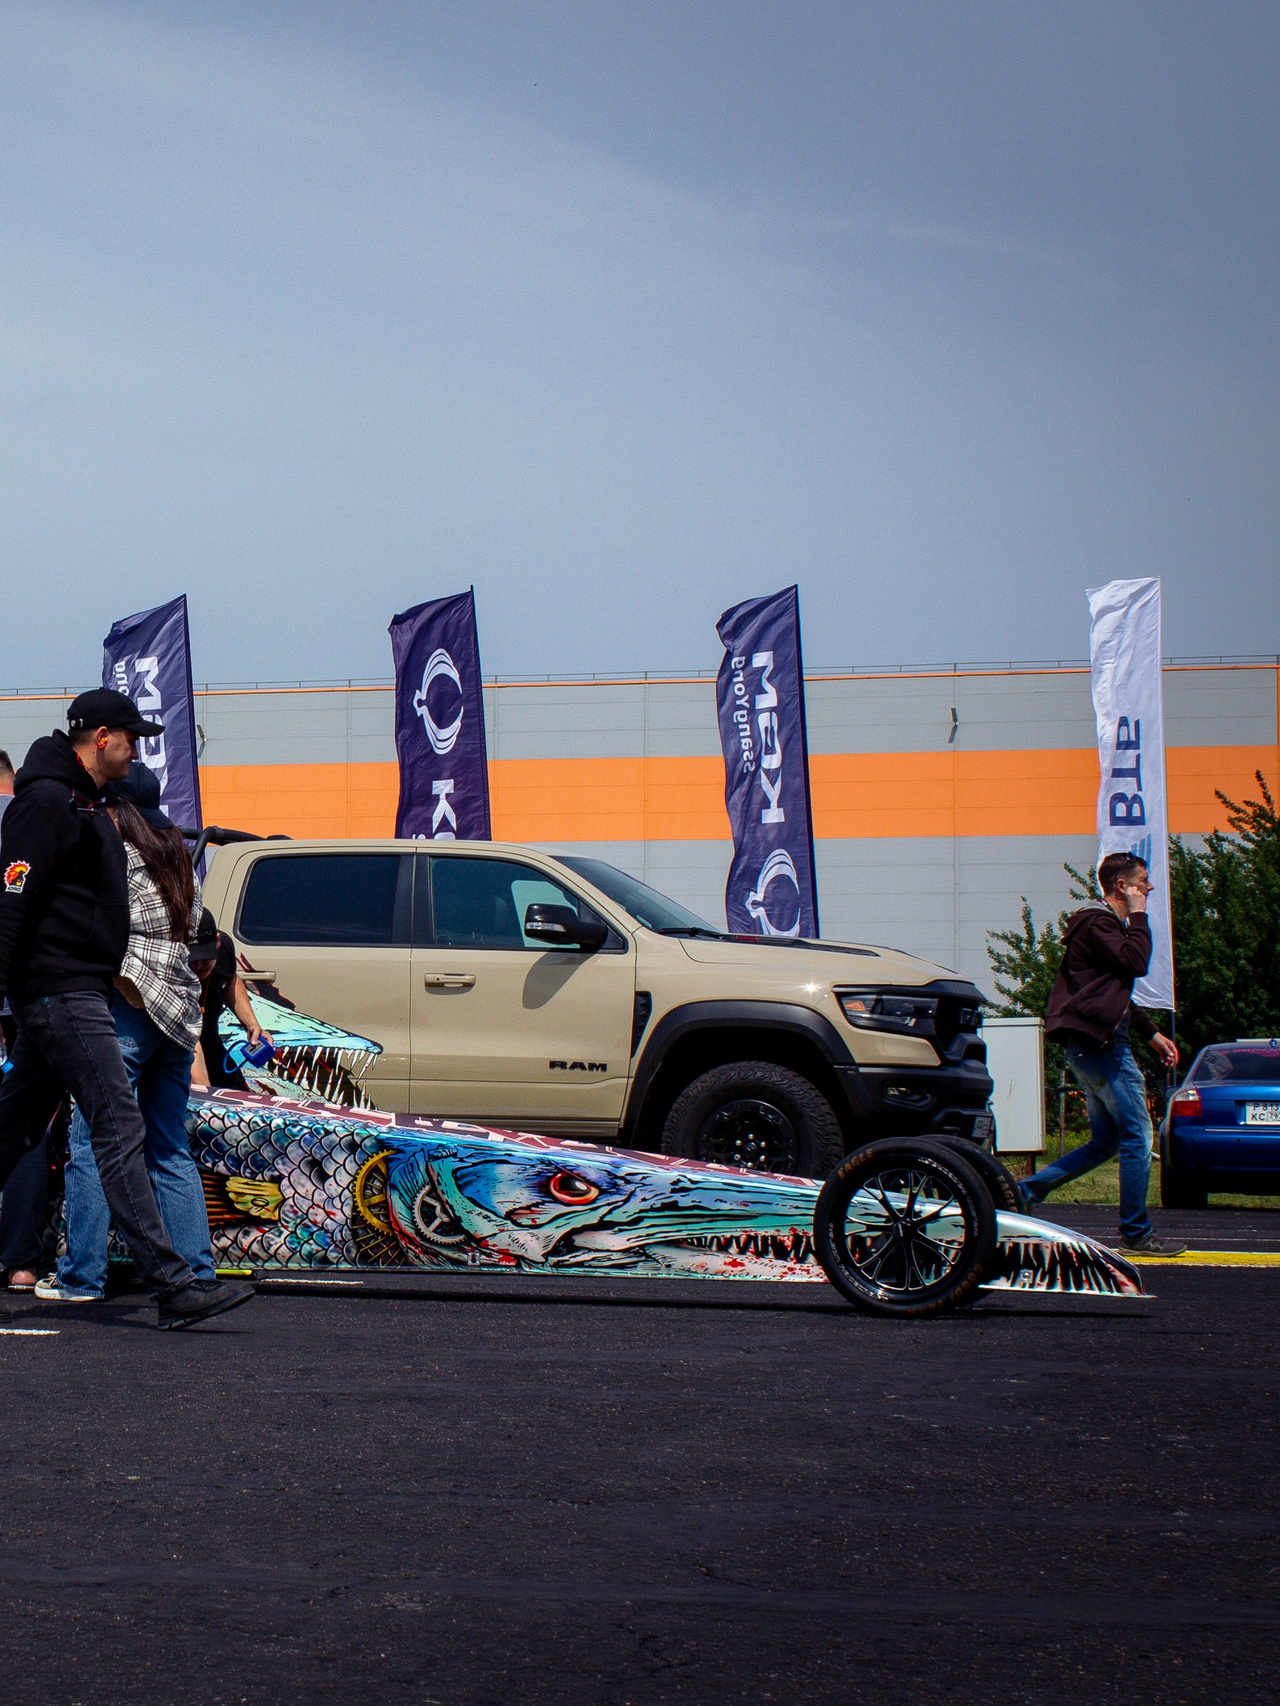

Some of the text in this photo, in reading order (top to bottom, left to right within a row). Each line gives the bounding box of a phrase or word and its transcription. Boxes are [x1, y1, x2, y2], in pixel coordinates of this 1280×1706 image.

[549, 1060, 608, 1072] RAM
[837, 1149, 874, 1179] EAGLE
[995, 1175, 1018, 1213] EAGLE
